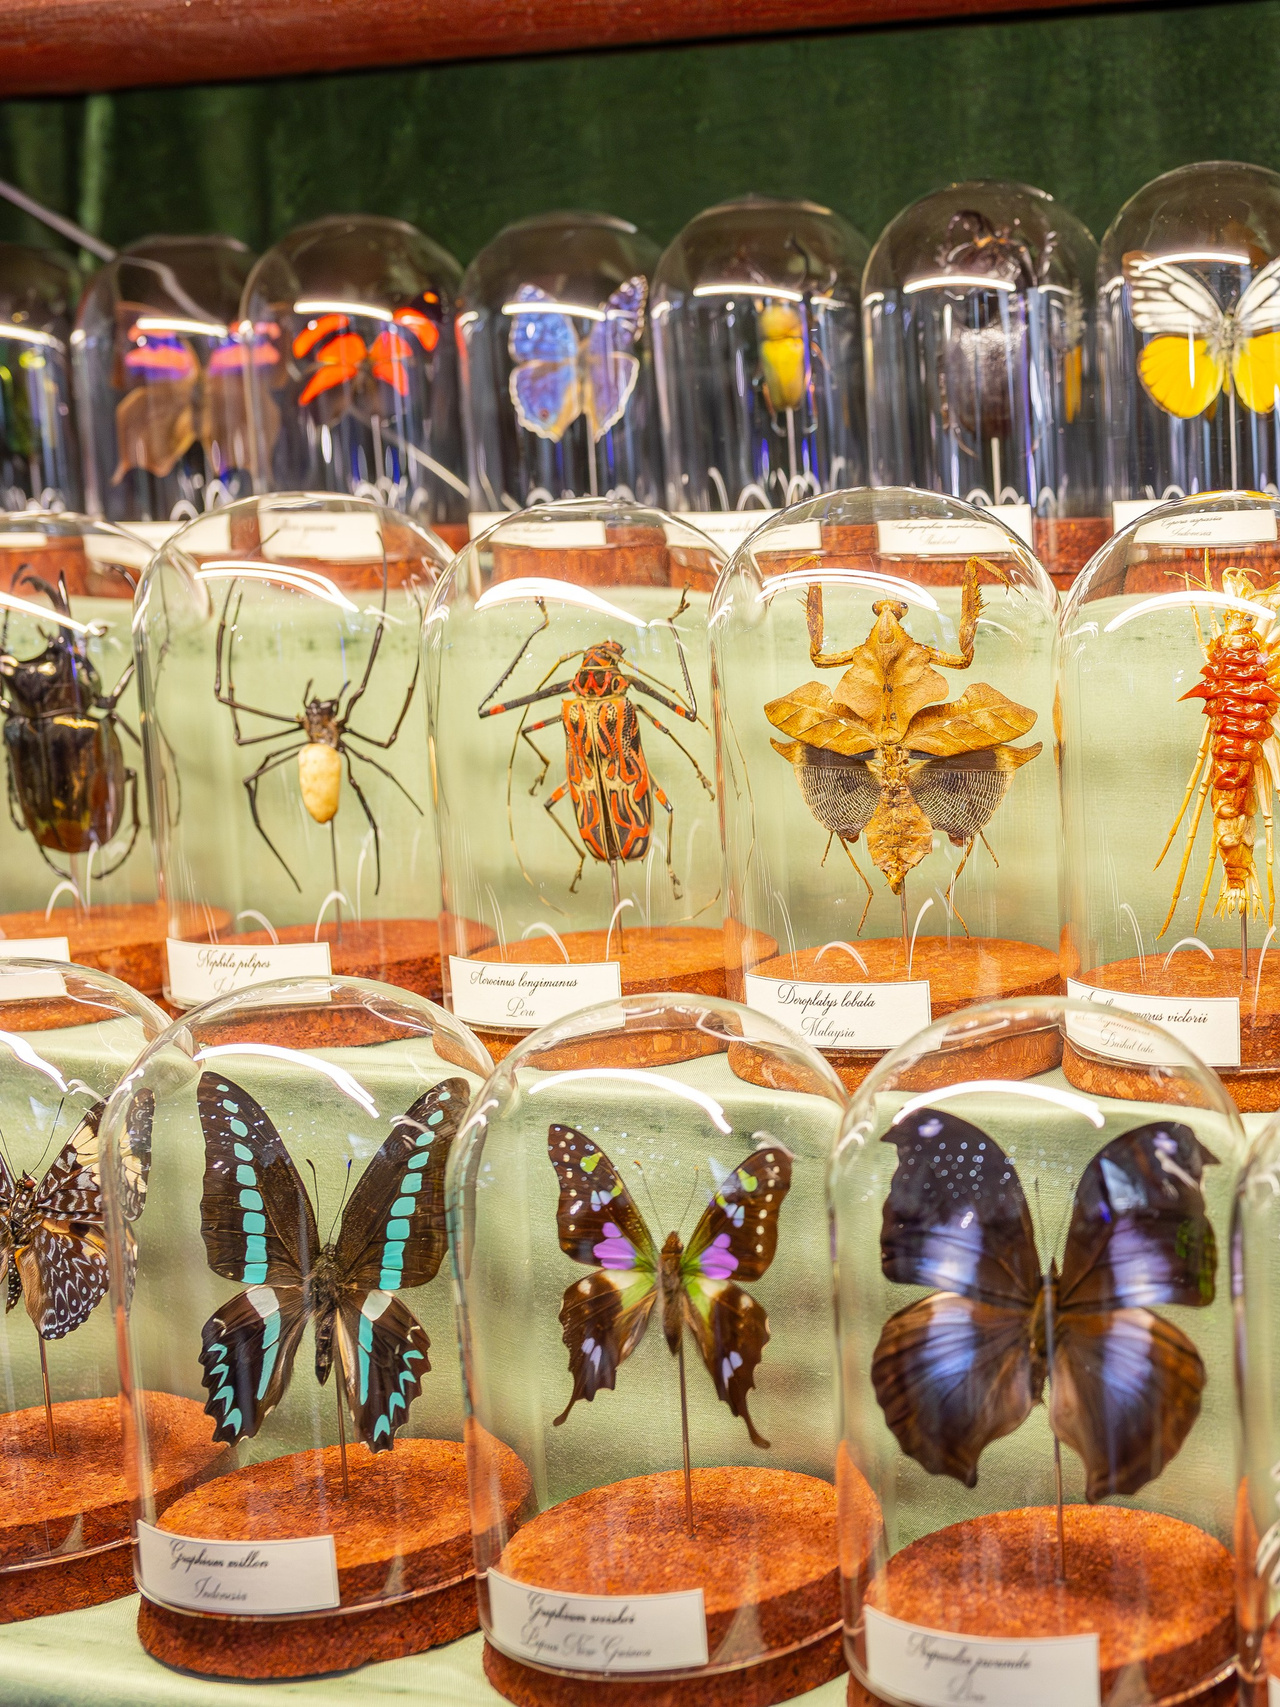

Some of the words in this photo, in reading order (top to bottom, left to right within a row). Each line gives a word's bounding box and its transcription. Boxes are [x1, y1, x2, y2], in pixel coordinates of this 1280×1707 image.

[517, 971, 578, 997] longimanus
[506, 996, 536, 1018] Peru
[777, 984, 838, 1016] Deroplatys
[840, 990, 876, 1008] lobata
[1167, 1008, 1209, 1024] victorii
[801, 1016, 856, 1046] Malaysia
